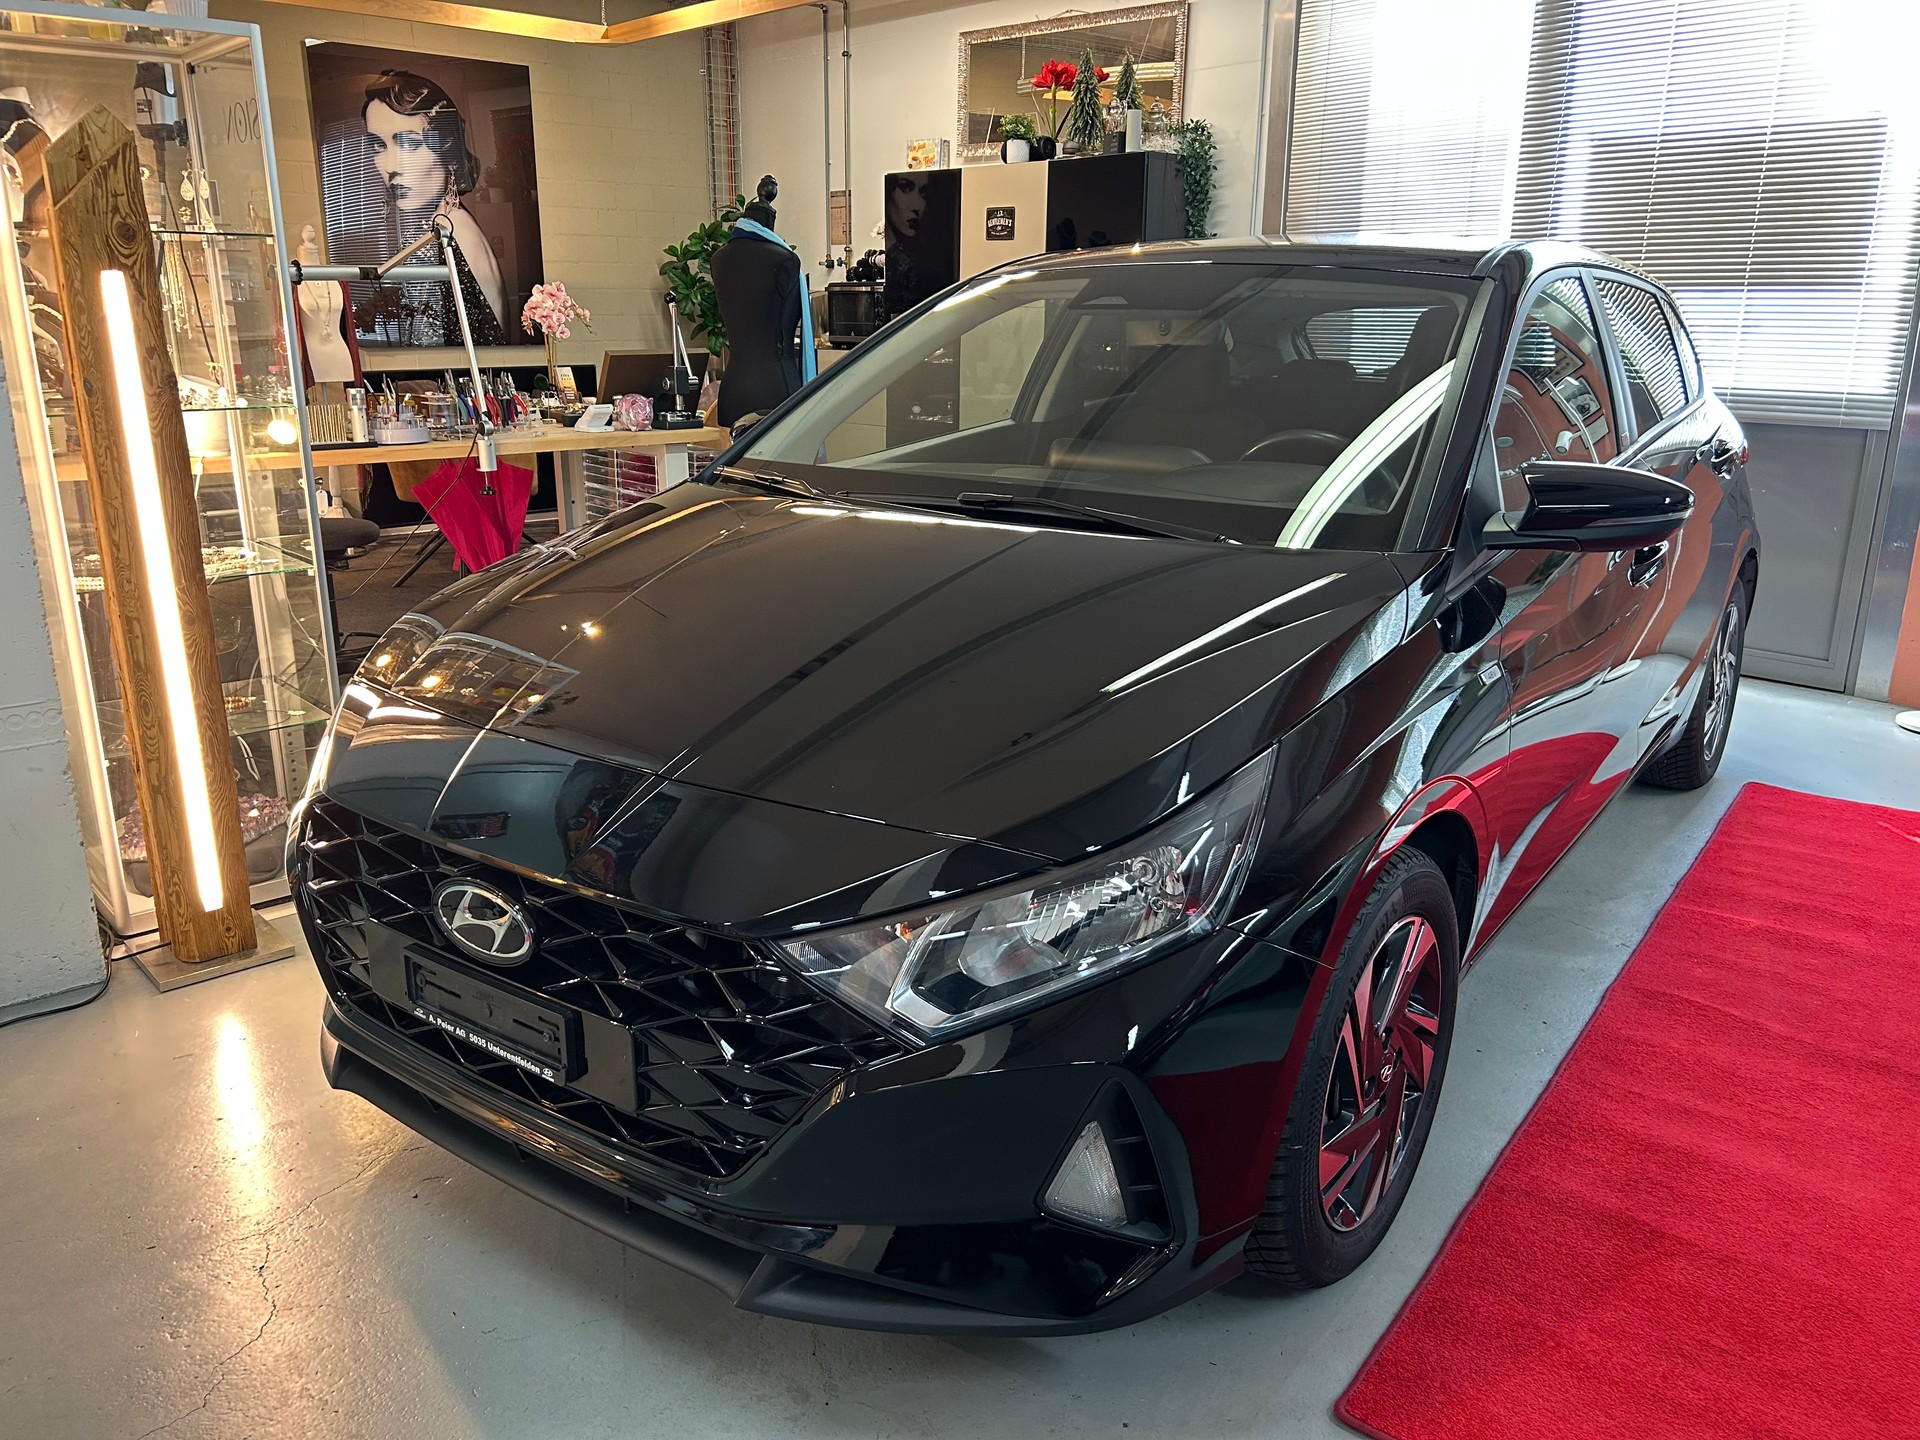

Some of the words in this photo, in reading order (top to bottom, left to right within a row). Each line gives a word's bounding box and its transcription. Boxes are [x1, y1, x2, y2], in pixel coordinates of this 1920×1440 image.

[428, 1014, 436, 1024] A.
[455, 1027, 466, 1038] AG
[469, 1033, 487, 1048] 5035
[487, 1042, 541, 1074] Unterentfelden
